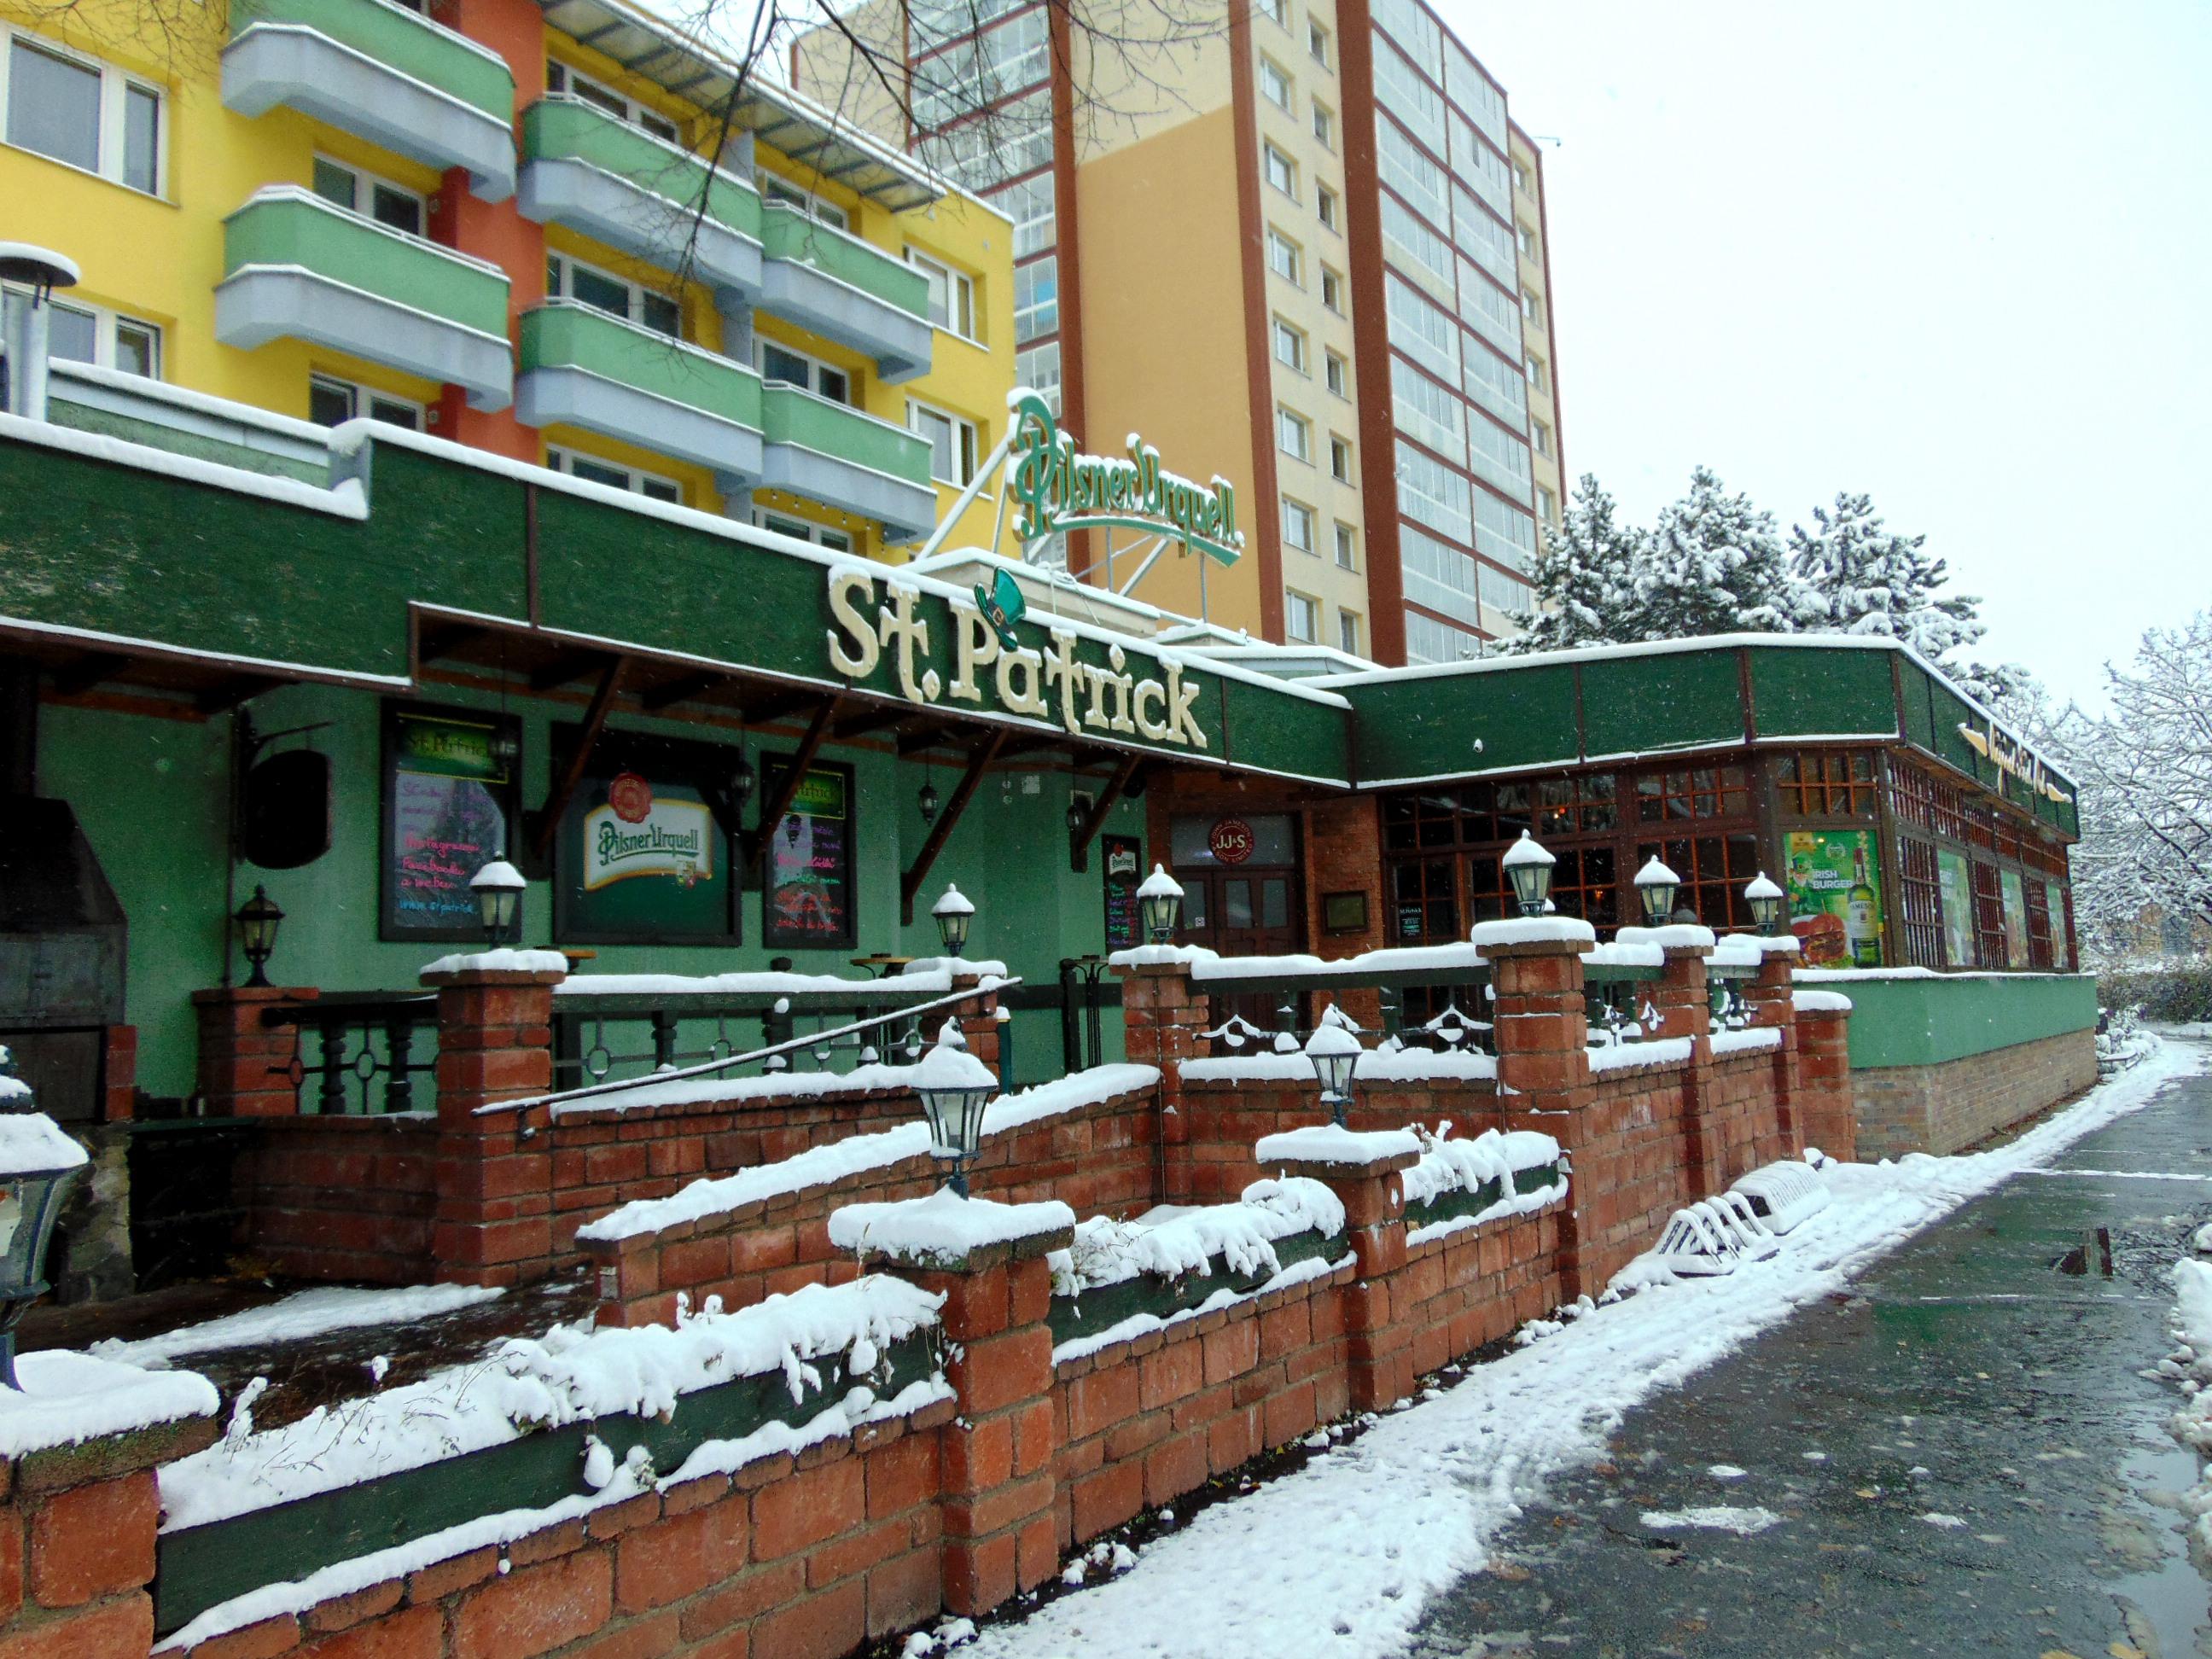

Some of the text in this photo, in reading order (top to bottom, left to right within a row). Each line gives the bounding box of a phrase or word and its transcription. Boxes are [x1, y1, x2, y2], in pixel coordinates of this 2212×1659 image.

[1007, 387, 1244, 556] Pilsner Urquell
[827, 564, 1208, 748] St. Patrick
[598, 820, 699, 866] Pilsner Urquell
[1813, 869, 1838, 879] IRISH
[1813, 879, 1854, 889] BURGER
